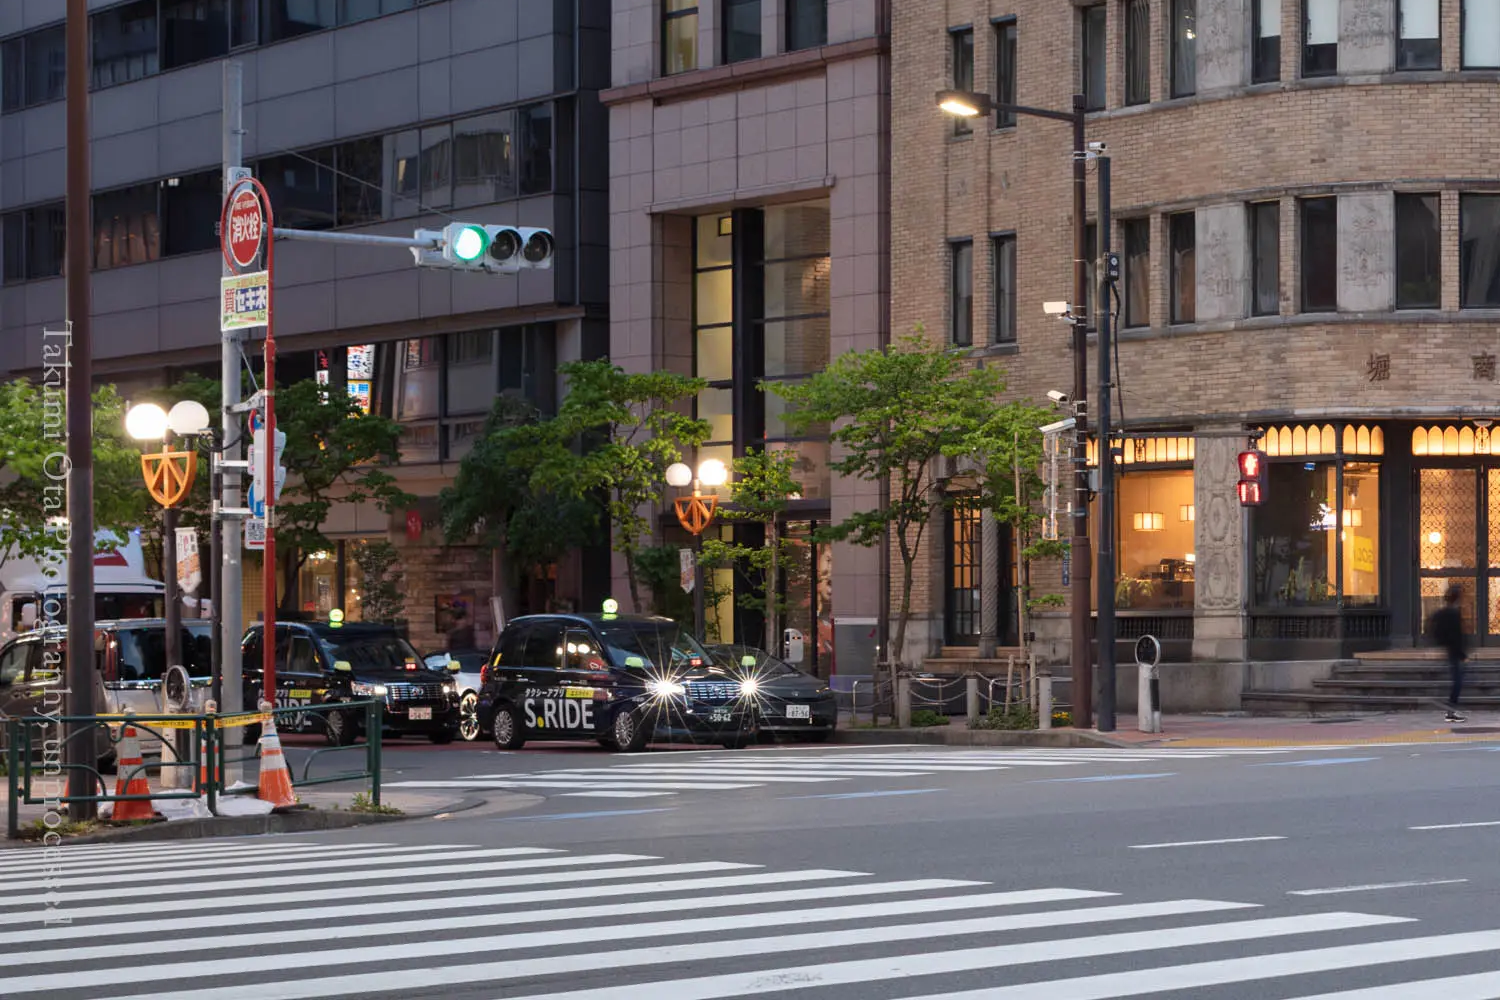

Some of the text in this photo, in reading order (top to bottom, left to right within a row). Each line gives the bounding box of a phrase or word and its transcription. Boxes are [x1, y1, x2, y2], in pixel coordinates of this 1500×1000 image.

[232, 211, 259, 243] 消火栓
[525, 687, 565, 698] タクシーアプリ
[524, 697, 596, 730] S.RIDE
